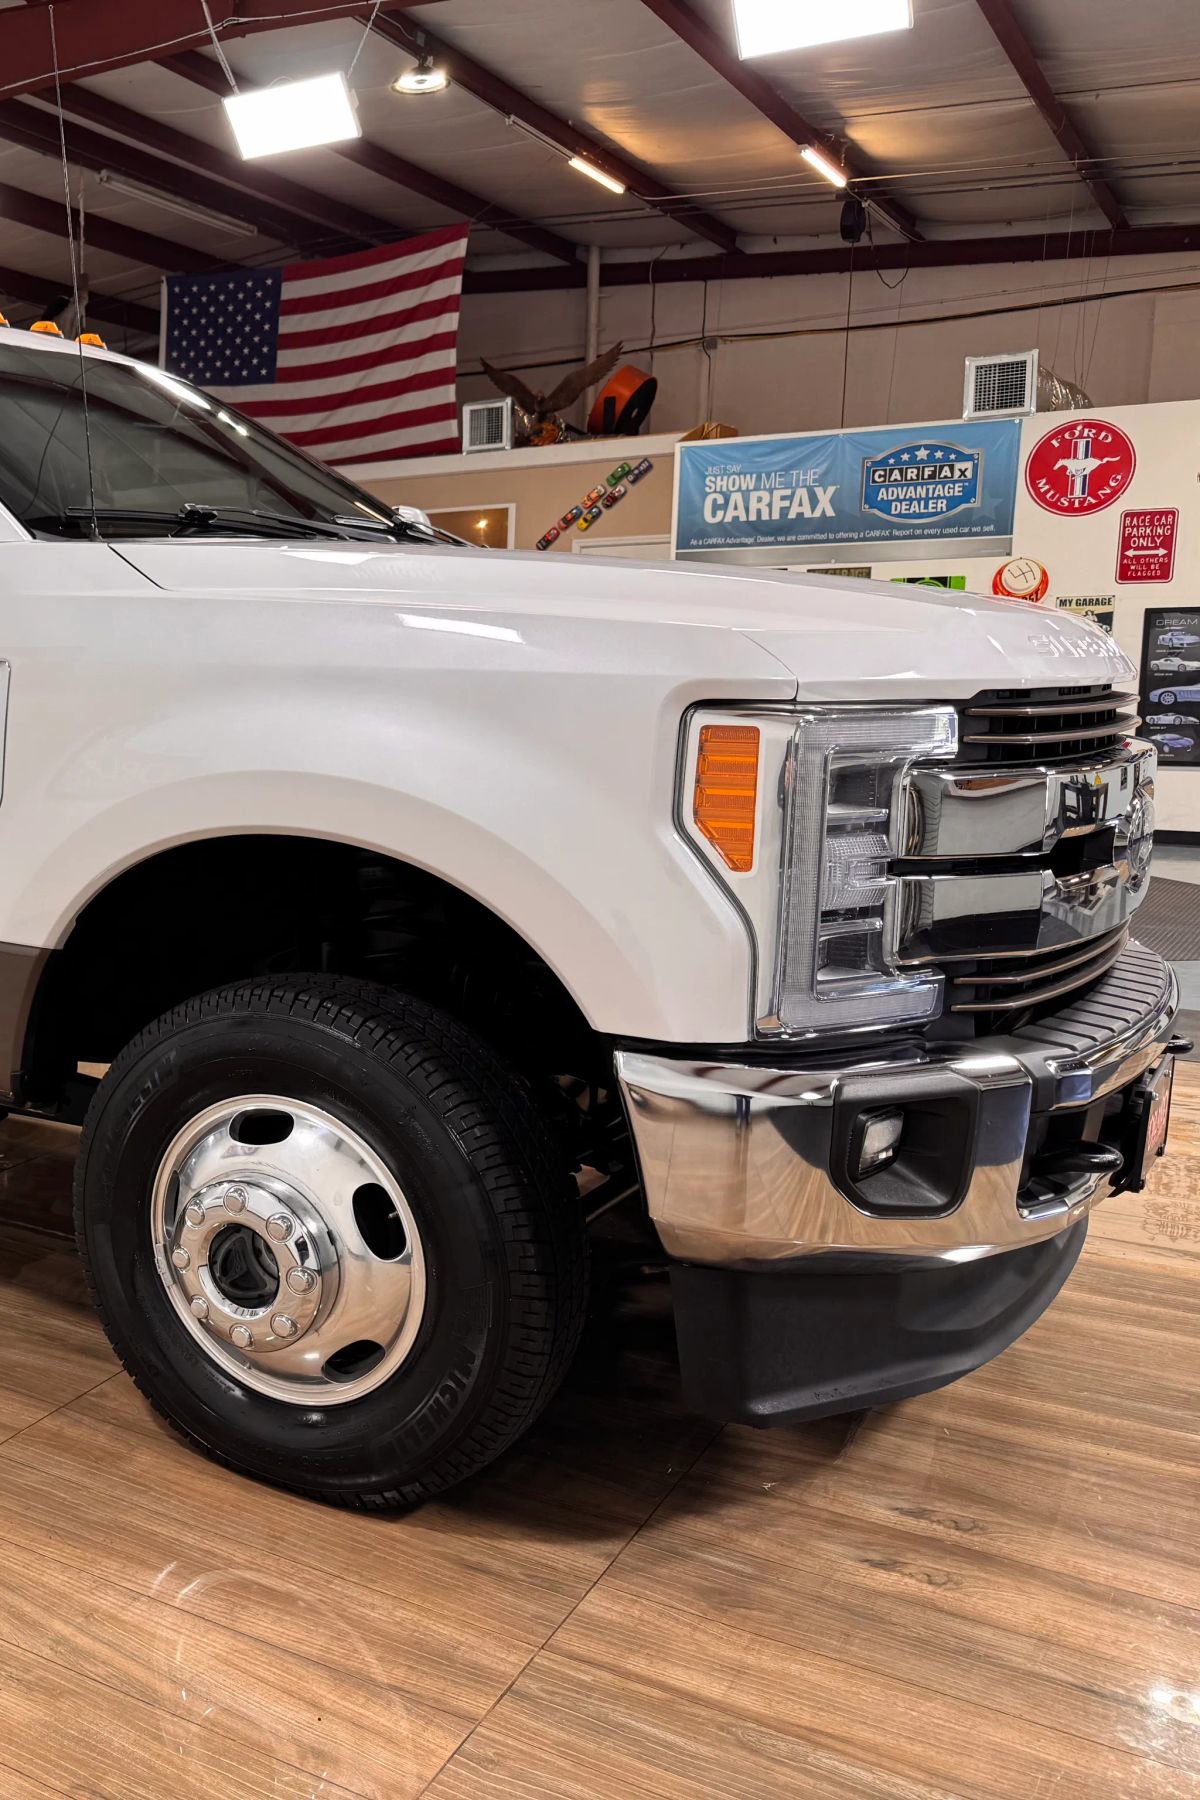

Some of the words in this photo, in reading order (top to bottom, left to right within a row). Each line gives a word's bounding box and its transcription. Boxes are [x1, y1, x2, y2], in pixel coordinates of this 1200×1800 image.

[1050, 427, 1113, 448] FORD
[704, 465, 726, 475] JUST
[726, 464, 742, 474] SAY
[873, 465, 969, 483] CARFAX
[704, 474, 757, 493] SHOW
[760, 471, 786, 489] ME
[790, 469, 821, 487] THE
[877, 483, 964, 501] ADVANTAGE
[1035, 472, 1123, 508] MUSTANG
[703, 485, 837, 524] CARFAX
[890, 499, 947, 514] DEALER
[1125, 515, 1151, 526] RACE
[1154, 514, 1173, 525] CAR
[690, 538, 698, 546] As
[703, 537, 726, 545] CARFAX
[725, 536, 752, 545] Advantage
[797, 533, 827, 541] committed
[836, 531, 859, 540] offering
[865, 529, 888, 538] CARFAX
[892, 528, 913, 537] Report
[924, 528, 941, 536] every
[942, 526, 958, 534] used
[1125, 525, 1171, 537] PARKING
[1130, 536, 1164, 547] ONLY
[1059, 598, 1074, 607] MY
[1075, 597, 1113, 607] GARAGE
[1156, 618, 1199, 627] DREAM
